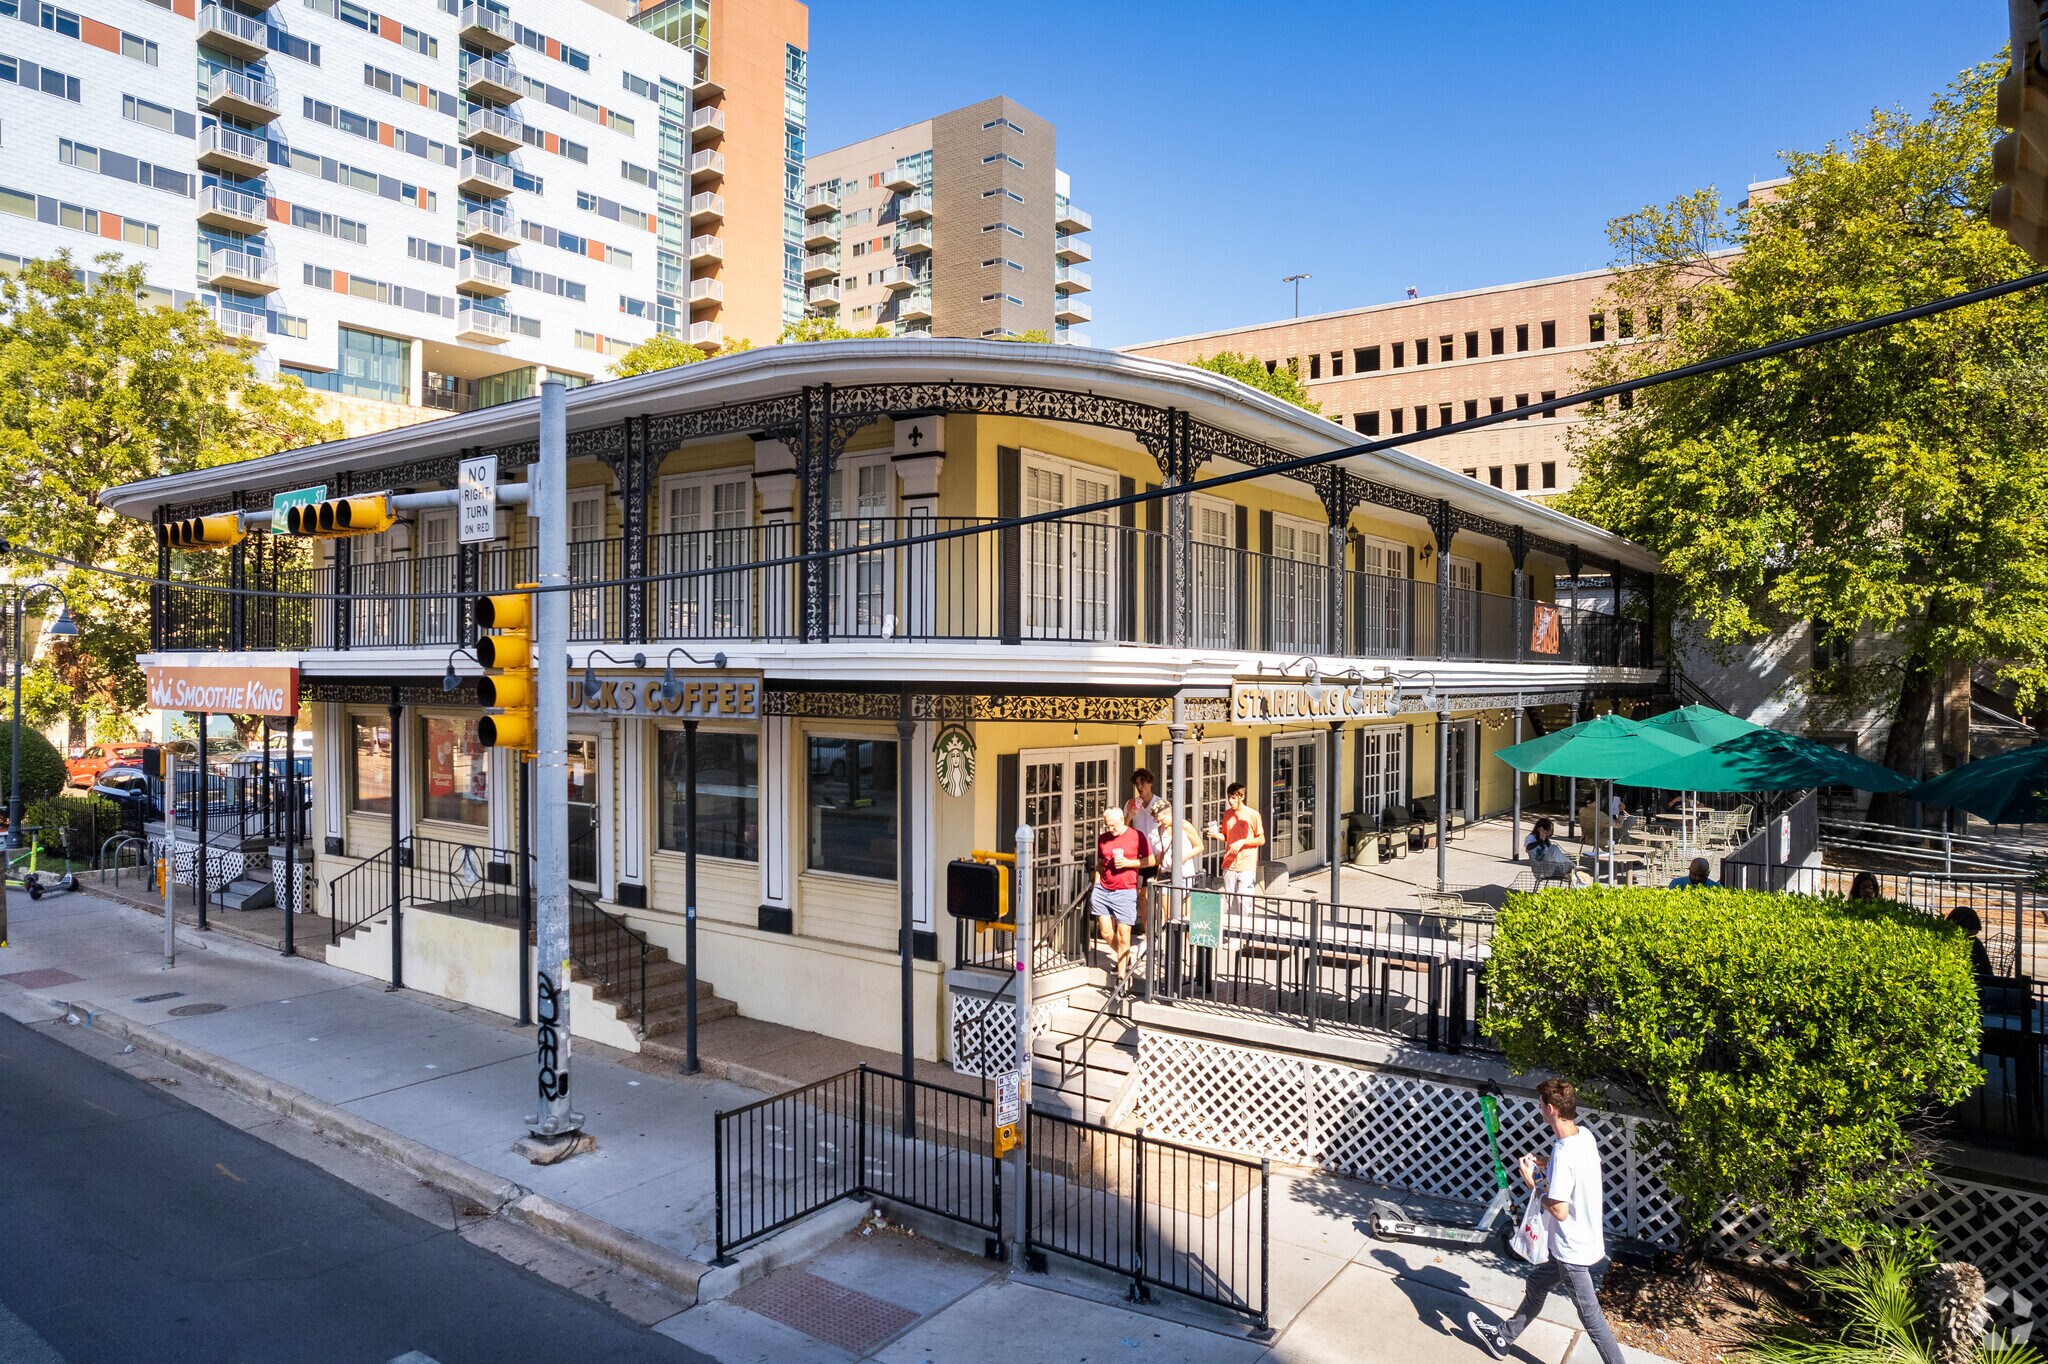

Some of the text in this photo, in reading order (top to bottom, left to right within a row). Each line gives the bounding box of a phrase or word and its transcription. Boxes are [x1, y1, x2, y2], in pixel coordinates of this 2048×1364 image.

[468, 466, 486, 483] NO
[465, 486, 490, 502] RIGHT
[466, 505, 488, 519] TURN
[465, 522, 490, 535] ON RED
[175, 679, 245, 709] SMOOTHIE
